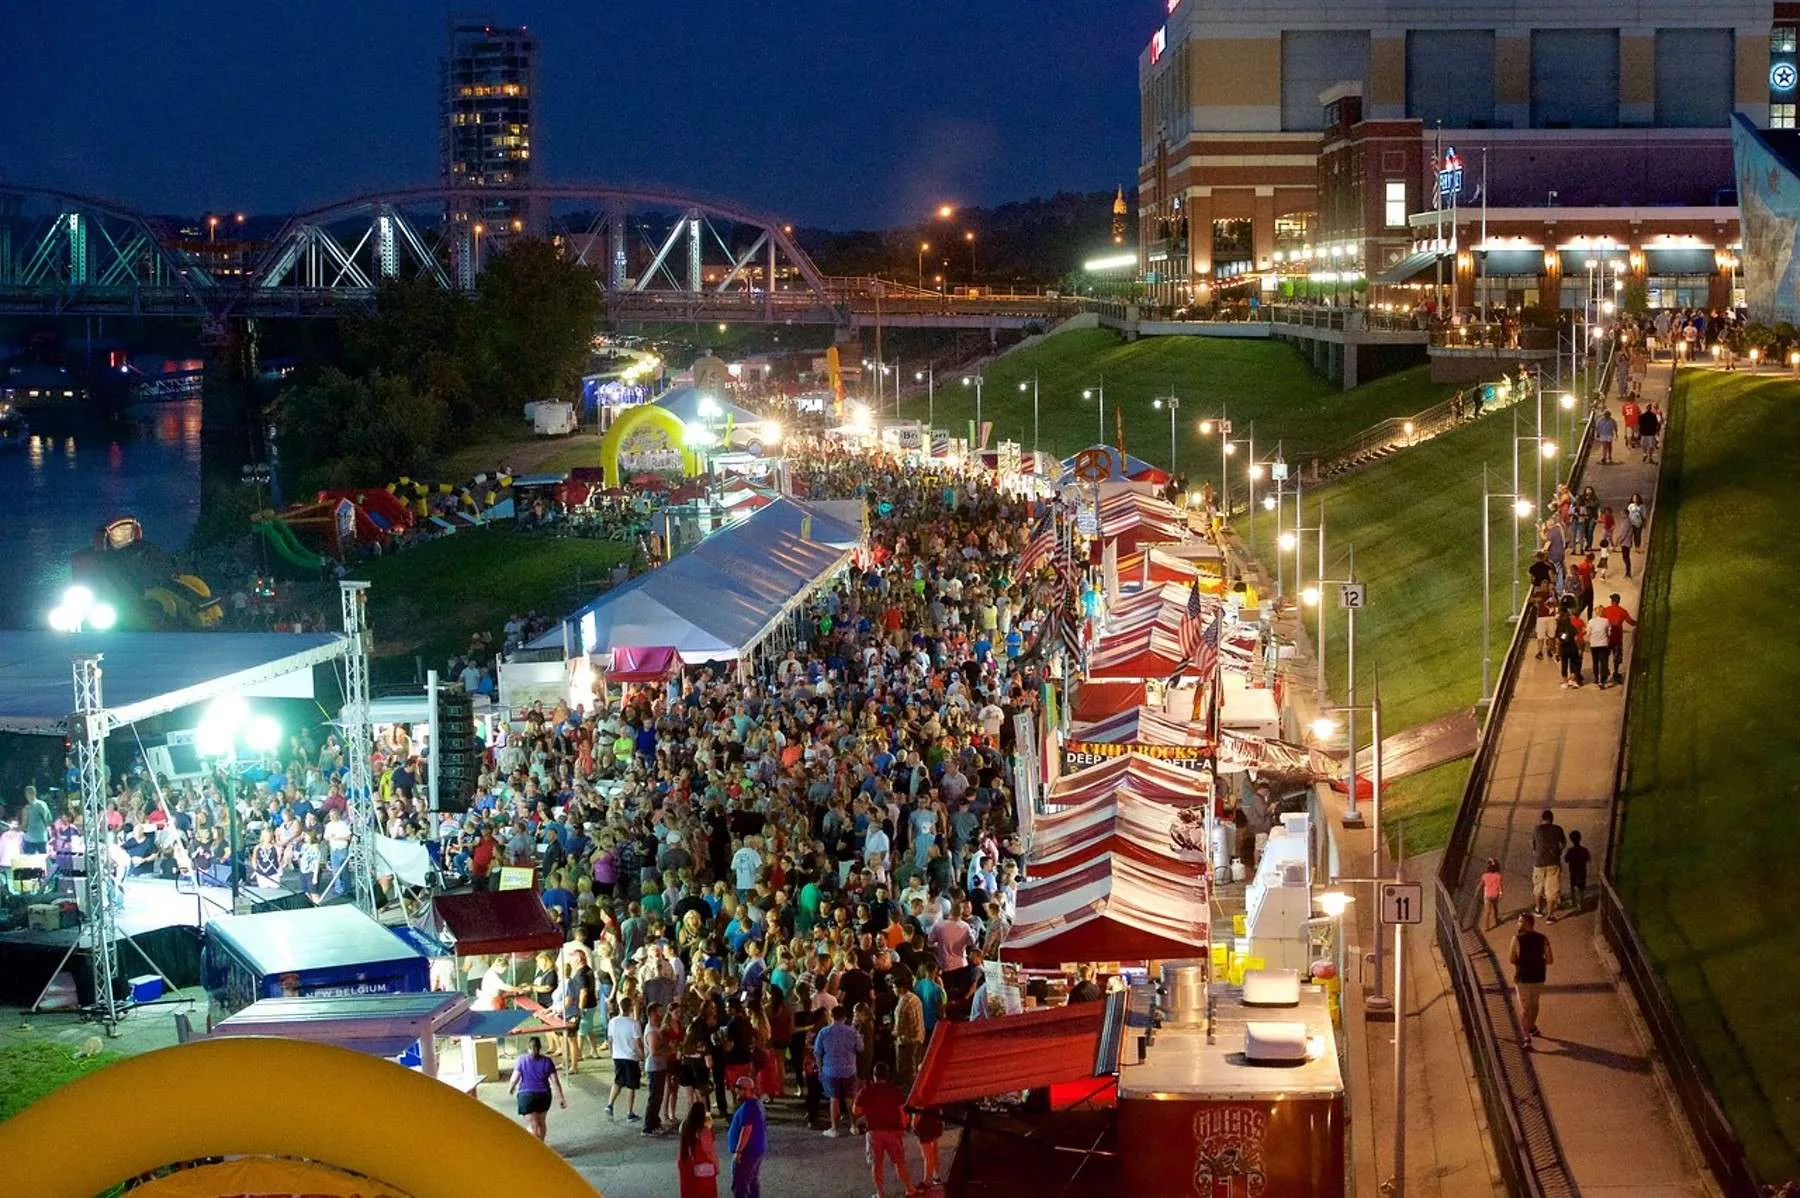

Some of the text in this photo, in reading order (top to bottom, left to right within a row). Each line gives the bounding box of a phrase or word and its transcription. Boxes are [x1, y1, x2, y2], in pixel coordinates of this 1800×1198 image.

[1344, 591, 1359, 606] 12
[1066, 752, 1102, 765] DEEP
[1396, 897, 1409, 920] 11
[335, 983, 387, 997] BELGIUM
